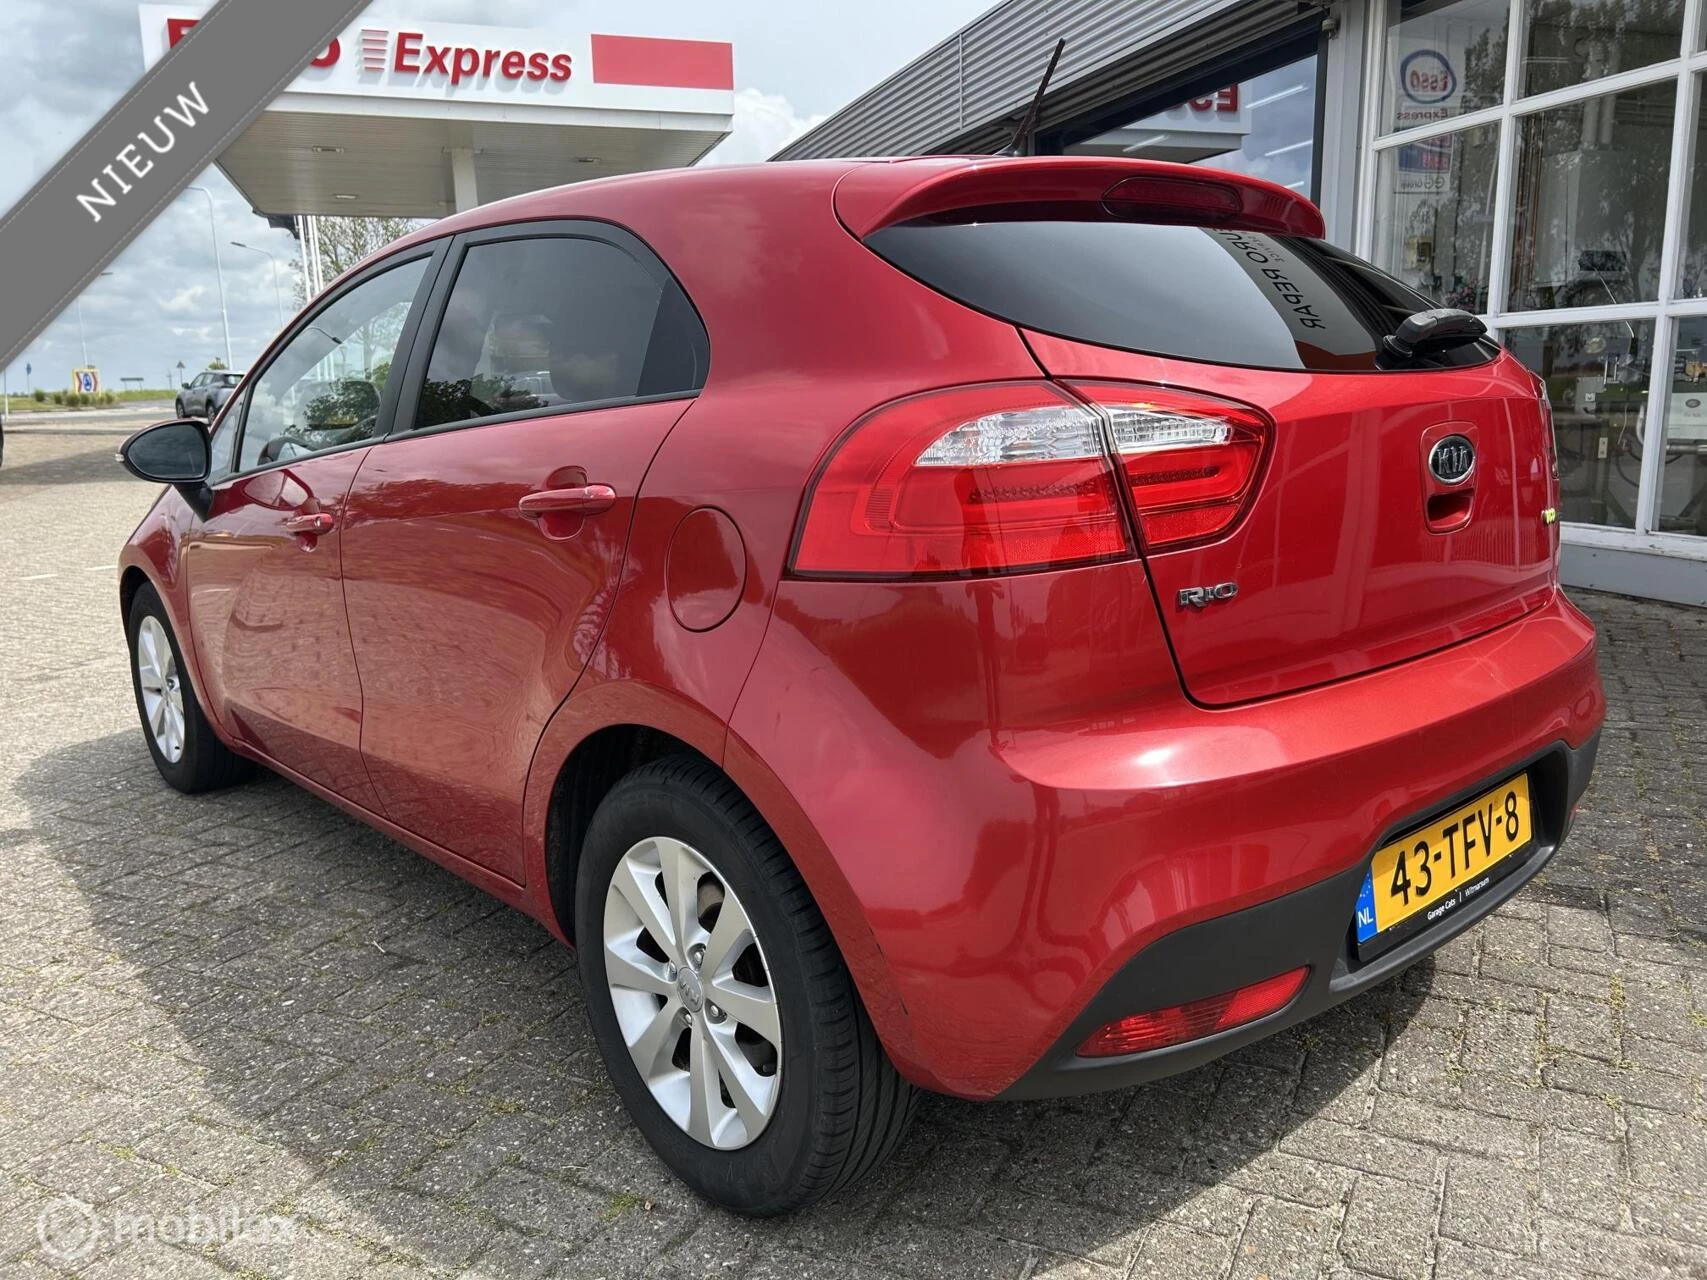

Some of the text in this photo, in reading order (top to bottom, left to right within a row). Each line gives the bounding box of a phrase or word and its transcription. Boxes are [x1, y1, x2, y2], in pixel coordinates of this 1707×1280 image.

[394, 32, 573, 86] Express
[1436, 446, 1474, 475] KIA
[1177, 582, 1238, 609] RIO
[1390, 791, 1519, 906] 43-TFV-8
[1358, 908, 1374, 927] NL
[1427, 905, 1445, 920] Garage
